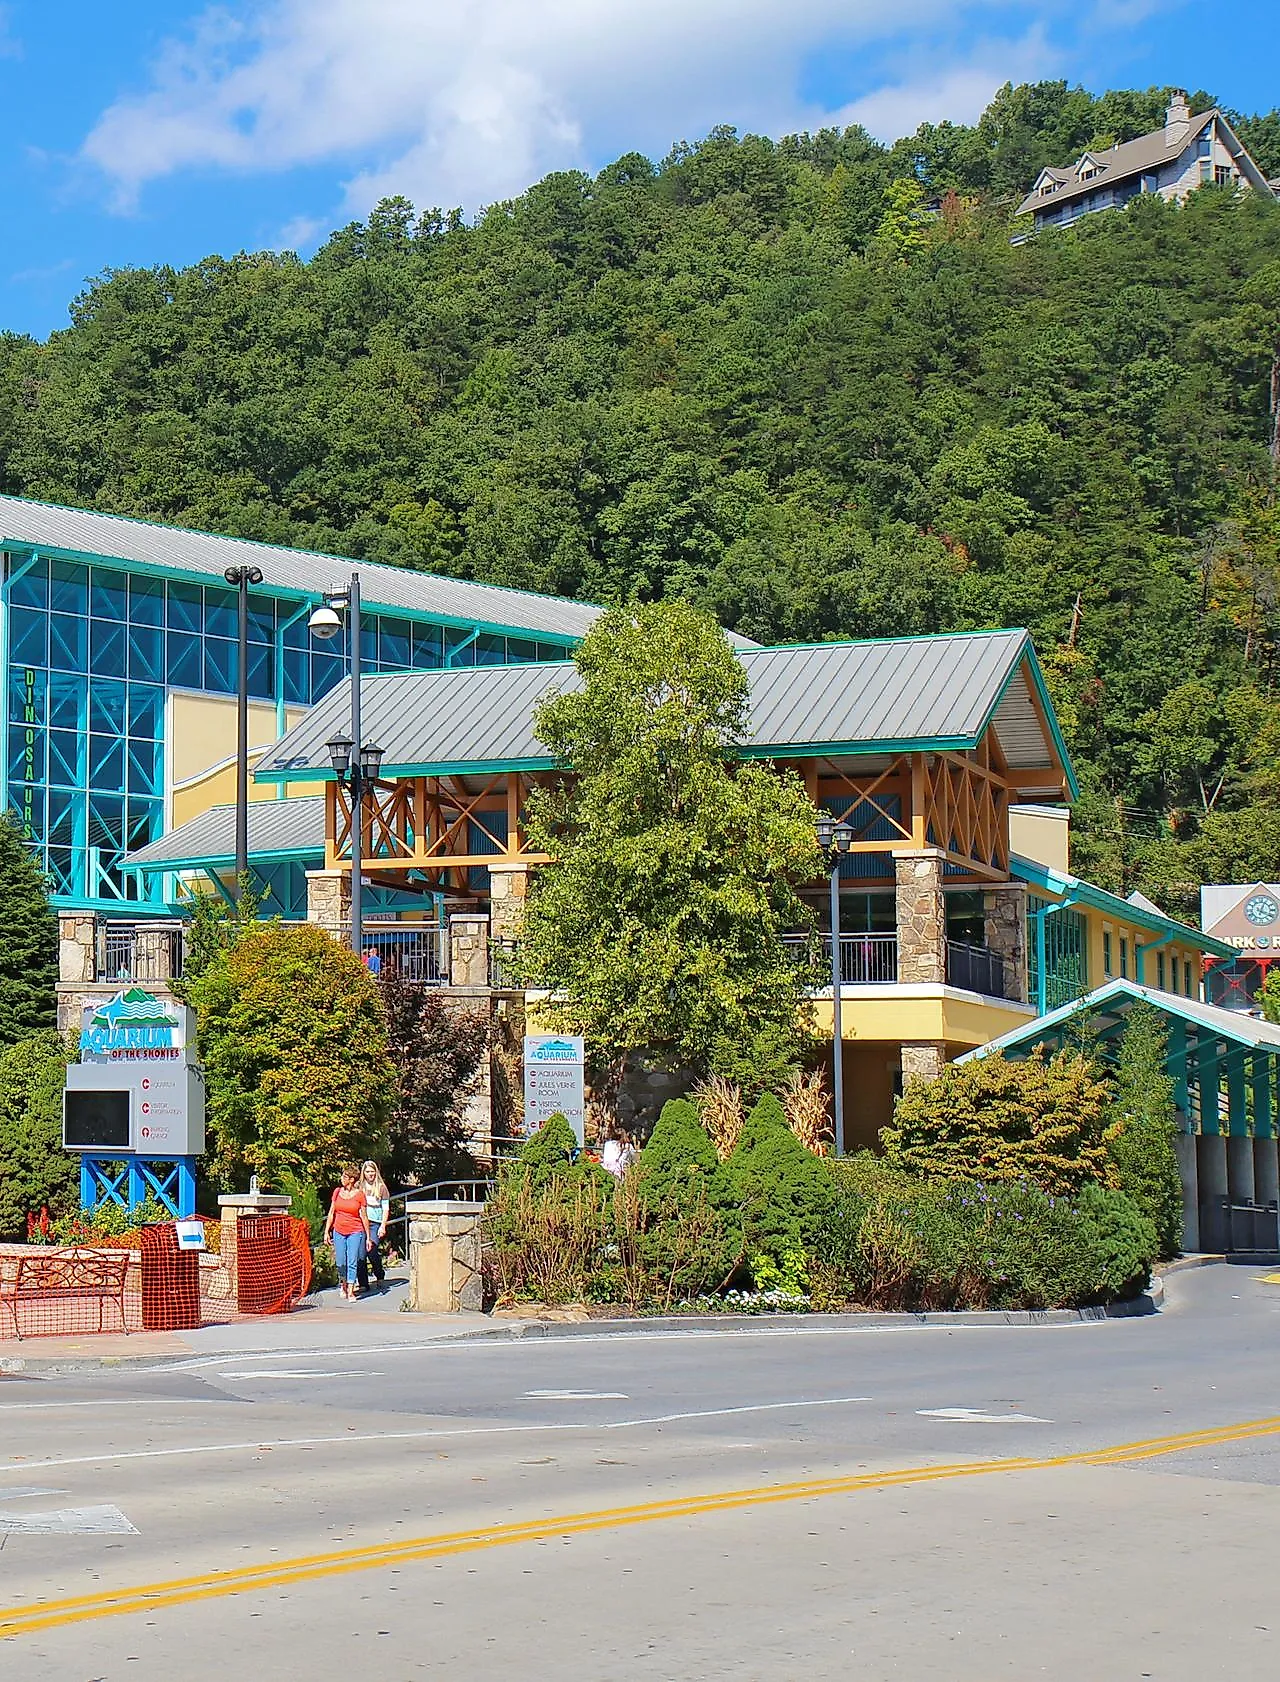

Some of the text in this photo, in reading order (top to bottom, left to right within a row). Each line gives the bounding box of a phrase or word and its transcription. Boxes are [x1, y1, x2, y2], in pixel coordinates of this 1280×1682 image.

[24, 668, 34, 839] DINOSAURS
[80, 1027, 172, 1054] AQUARIUM
[125, 1050, 140, 1058] THE
[143, 1049, 180, 1058] SMOKIES
[531, 1051, 577, 1059] AQUARIUM
[538, 1089, 559, 1097] ROOM
